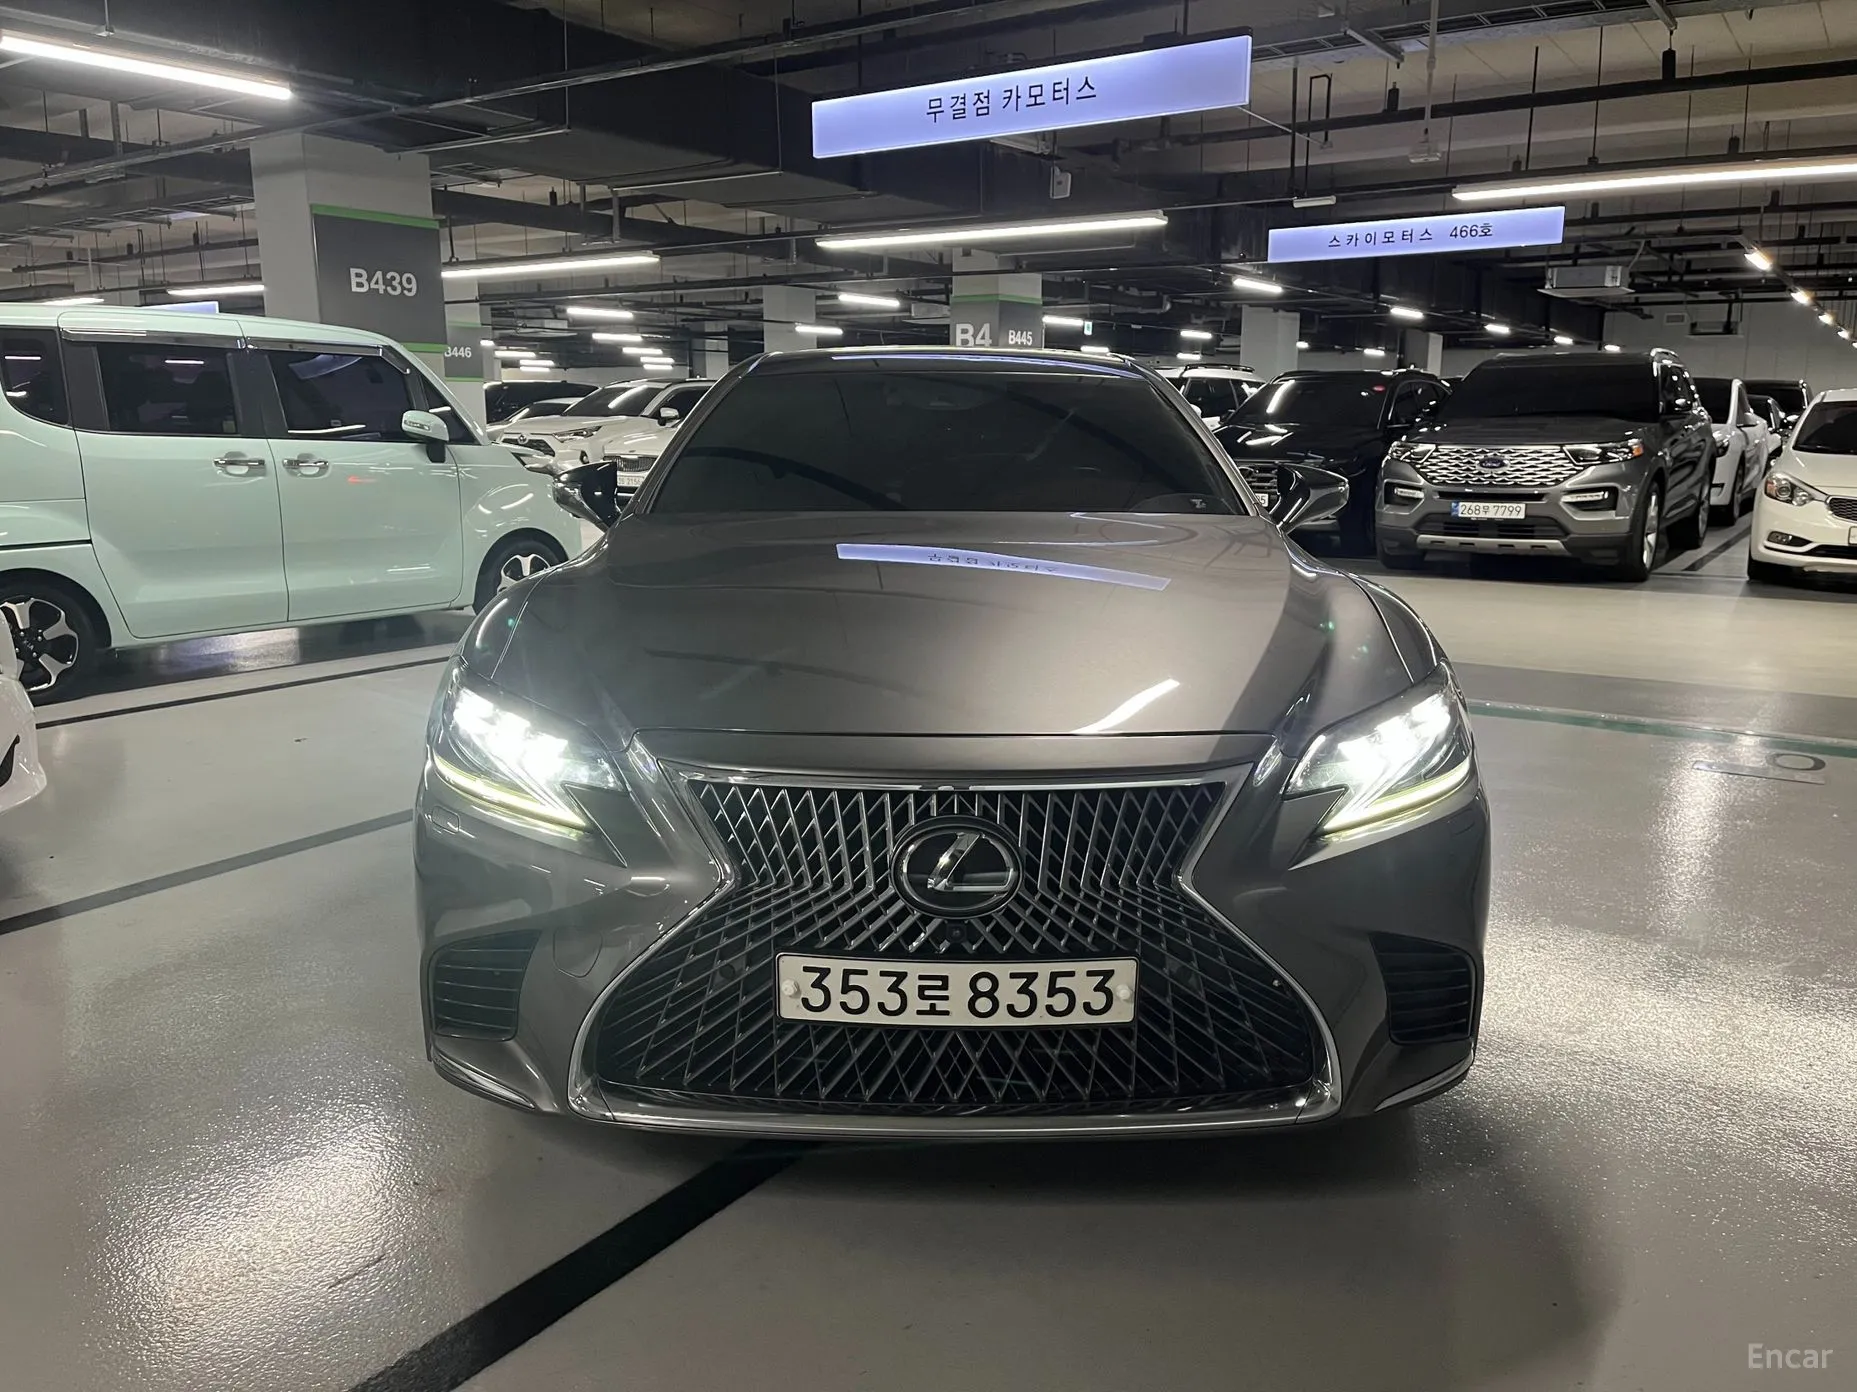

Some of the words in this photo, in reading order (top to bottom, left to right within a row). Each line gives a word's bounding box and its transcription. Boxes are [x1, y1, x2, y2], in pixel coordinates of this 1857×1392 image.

[926, 89, 991, 123] 무결점
[1002, 76, 1097, 112] 카모터스
[1328, 228, 1433, 248] 스카이모터스
[1449, 223, 1493, 239] 466호
[349, 267, 418, 297] B439
[955, 323, 993, 347] B4
[1008, 329, 1033, 346] B445
[801, 965, 951, 1017] 353로
[967, 969, 1116, 1019] 8353
